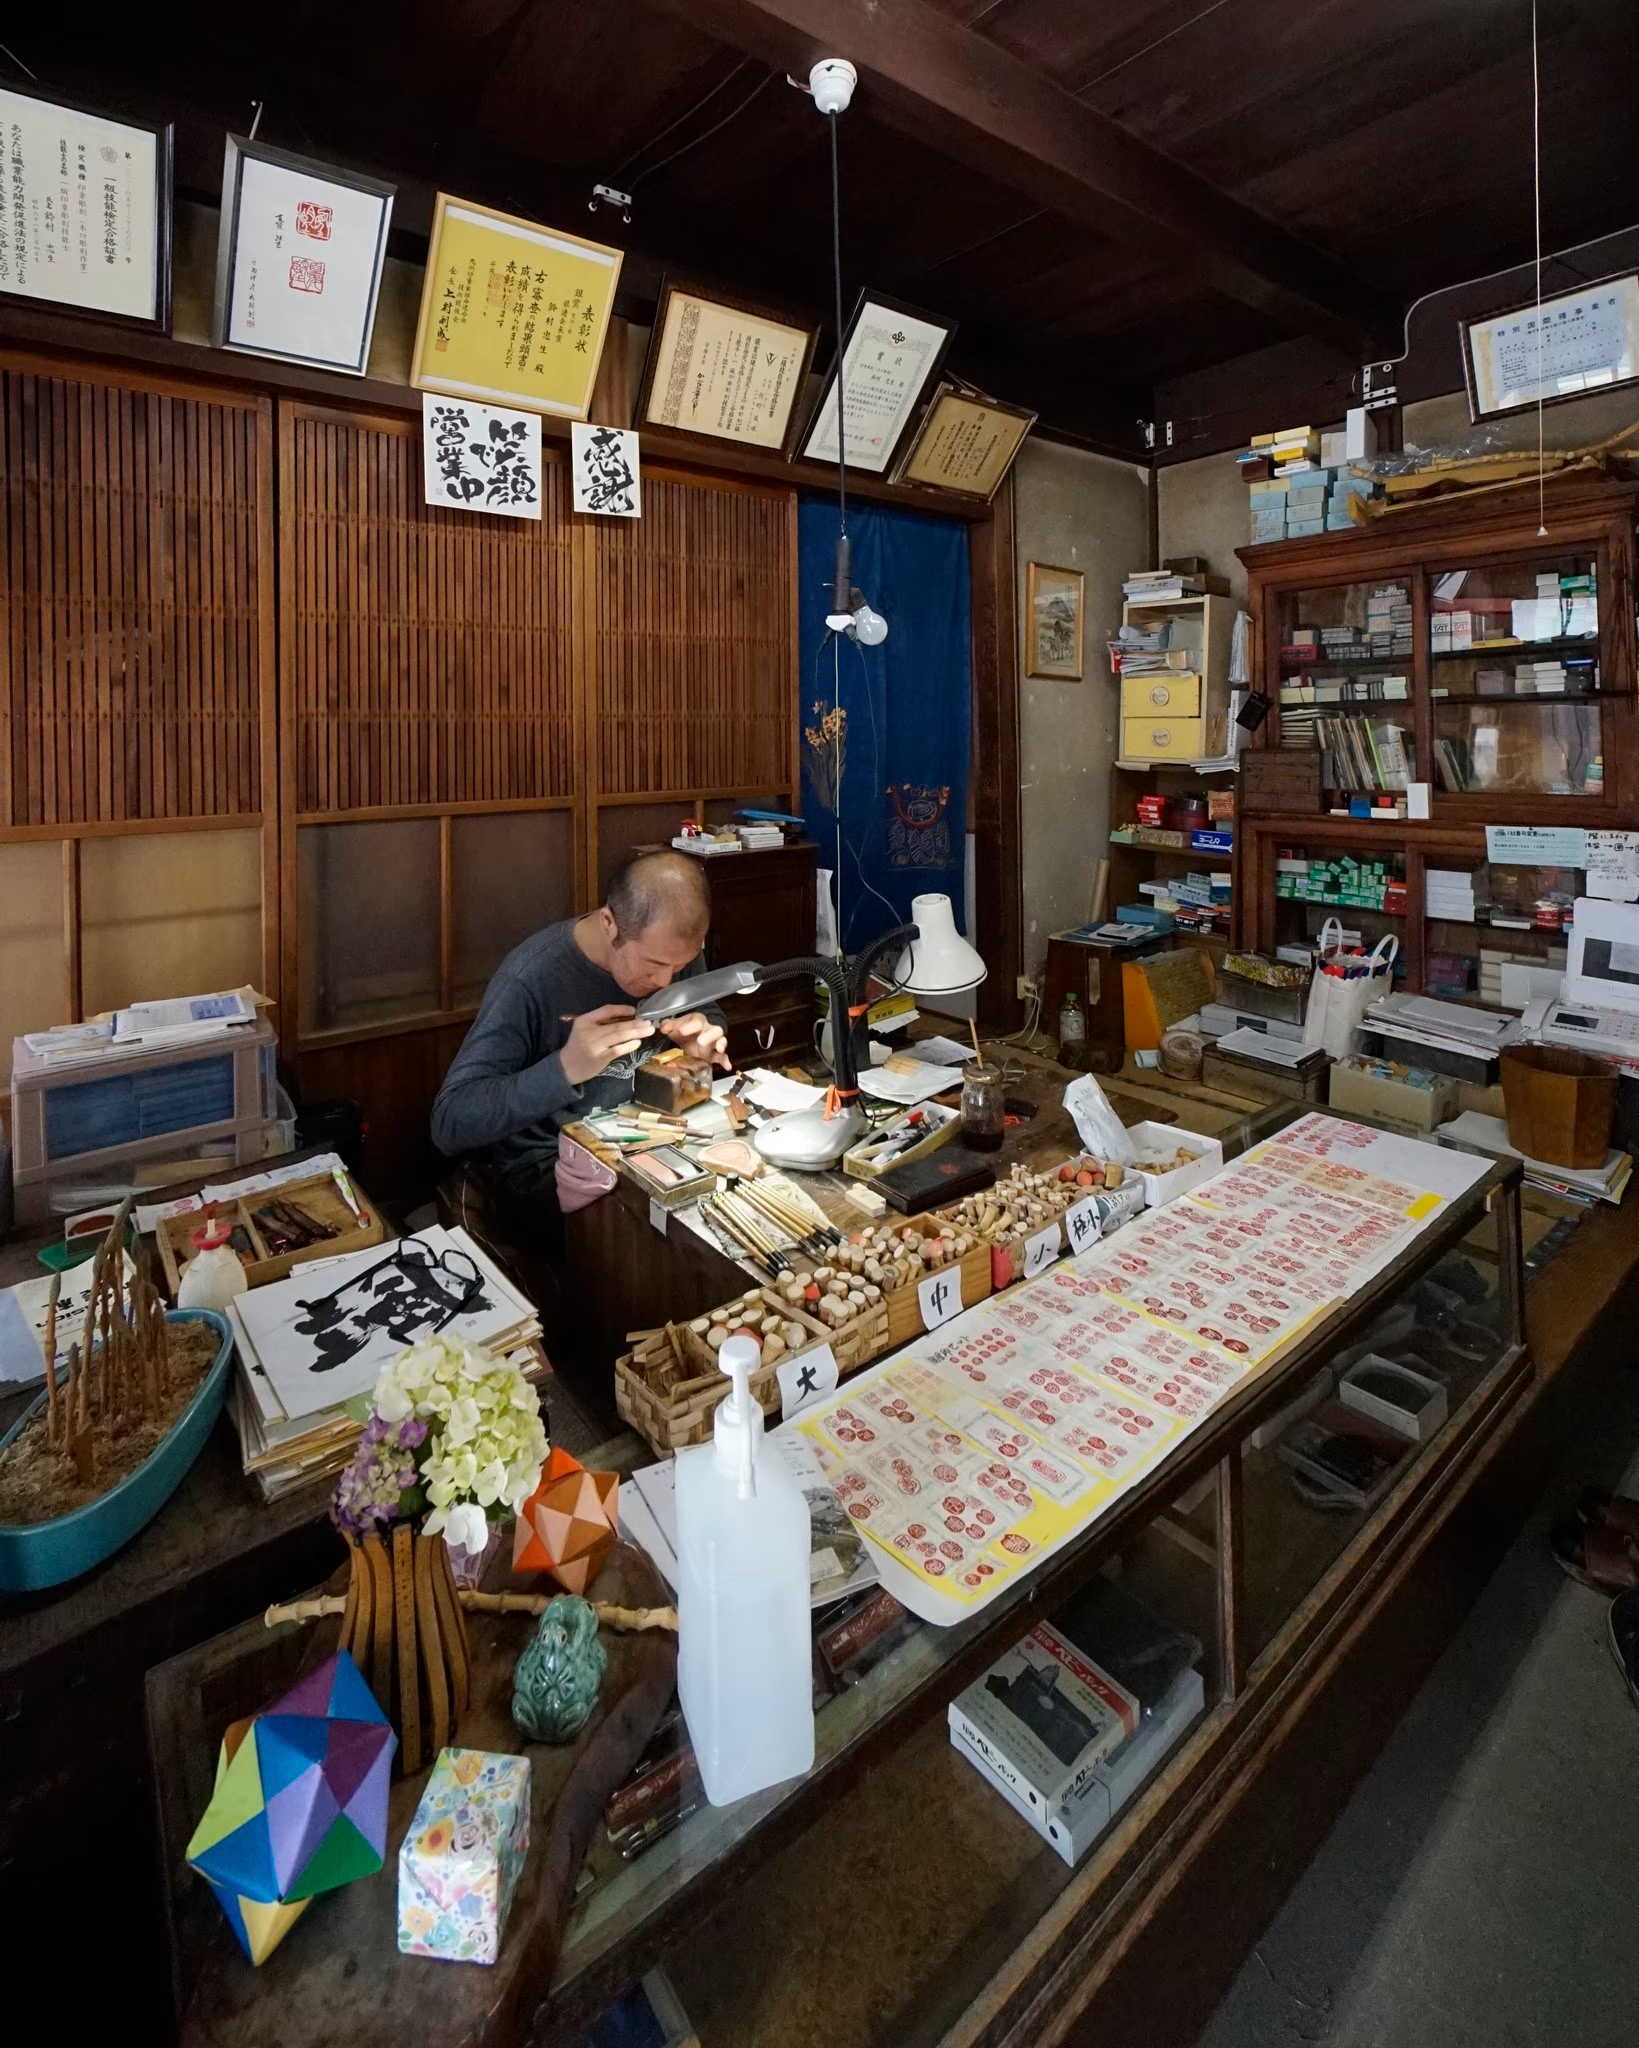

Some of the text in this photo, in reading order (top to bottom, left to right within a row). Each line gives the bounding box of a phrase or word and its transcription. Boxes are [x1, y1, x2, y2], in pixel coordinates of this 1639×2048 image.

[496, 259, 518, 328] 表彰いたします
[574, 304, 596, 354] 表彰状
[430, 407, 485, 504] 営業中
[582, 427, 635, 514] 感謝
[1072, 1207, 1102, 1242] 極小
[1033, 1243, 1053, 1265] 小
[930, 1280, 950, 1316] 中
[796, 1365, 824, 1403] 大
